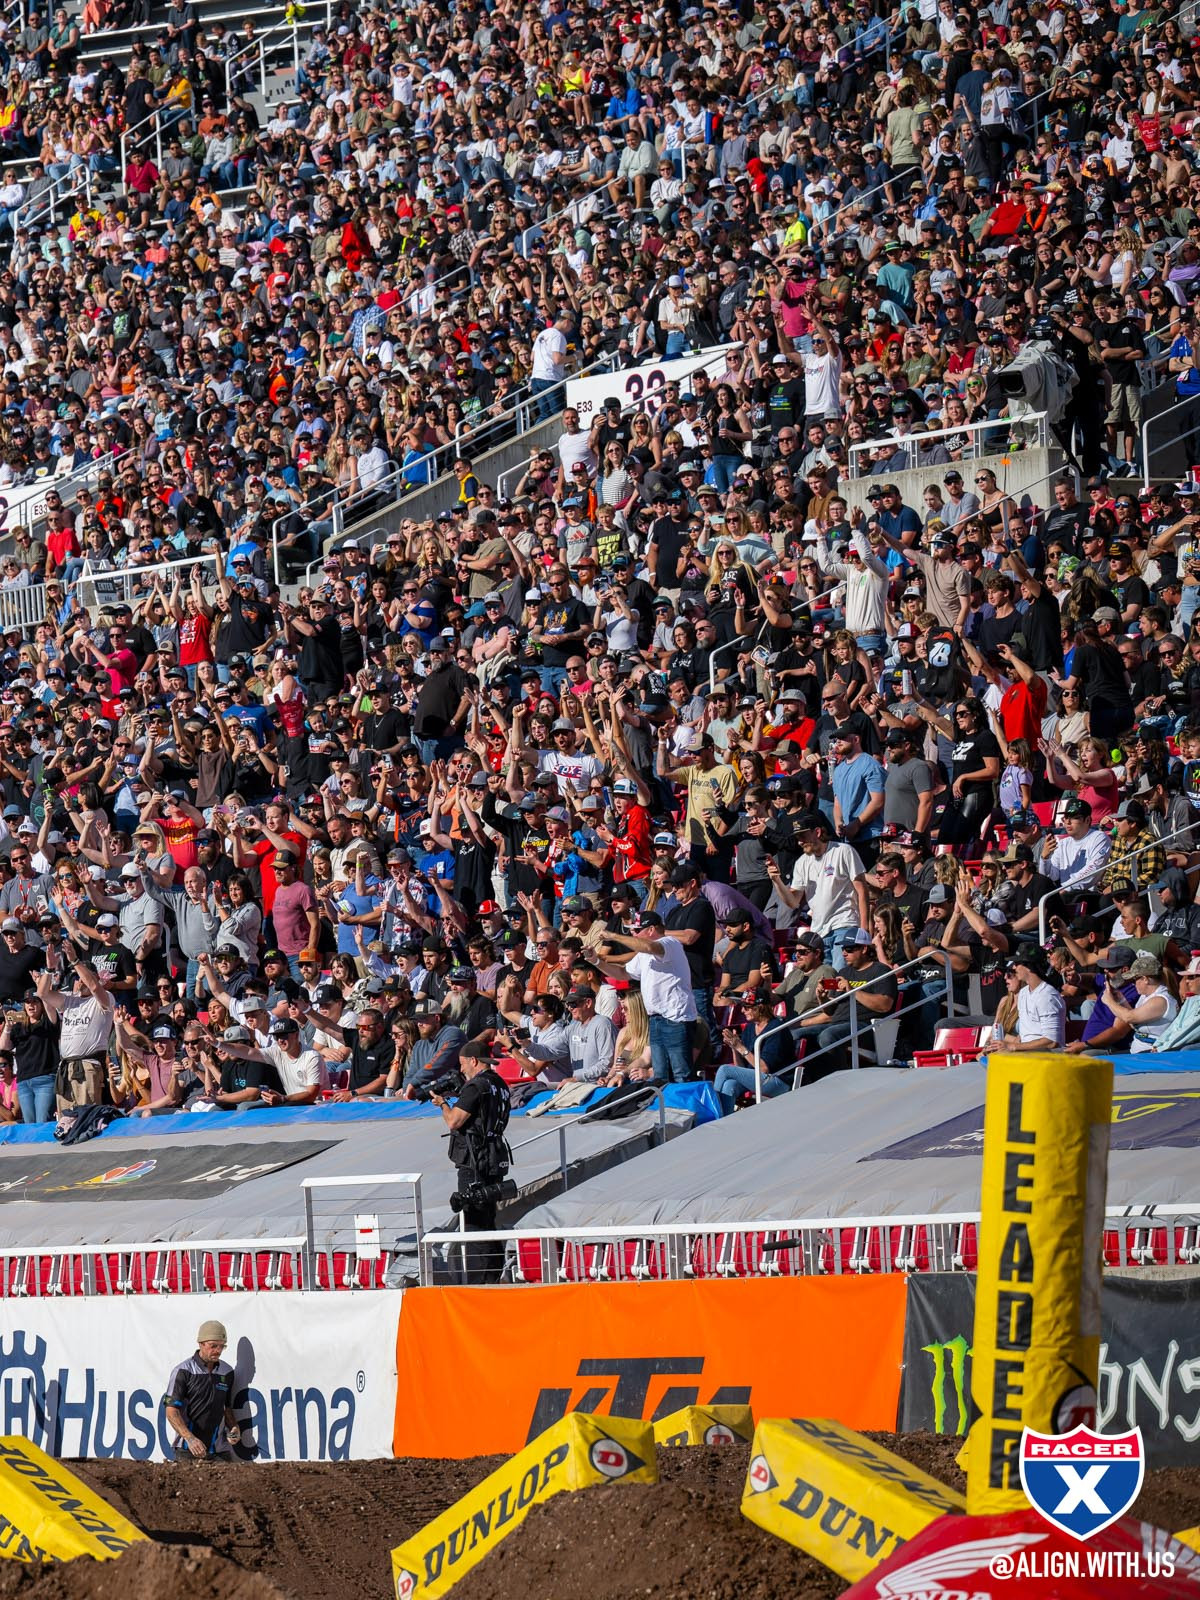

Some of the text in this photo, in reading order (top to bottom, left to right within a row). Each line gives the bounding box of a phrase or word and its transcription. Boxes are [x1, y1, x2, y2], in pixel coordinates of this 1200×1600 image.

[576, 401, 593, 414] E33
[625, 369, 666, 416] 33
[96, 582, 114, 592] ENTER
[929, 641, 952, 668] 18
[987, 1081, 1038, 1490] LEADER
[51, 1367, 356, 1463] Husarna
[423, 1442, 570, 1587] DUNLOP
[779, 1477, 909, 1565] DUN
